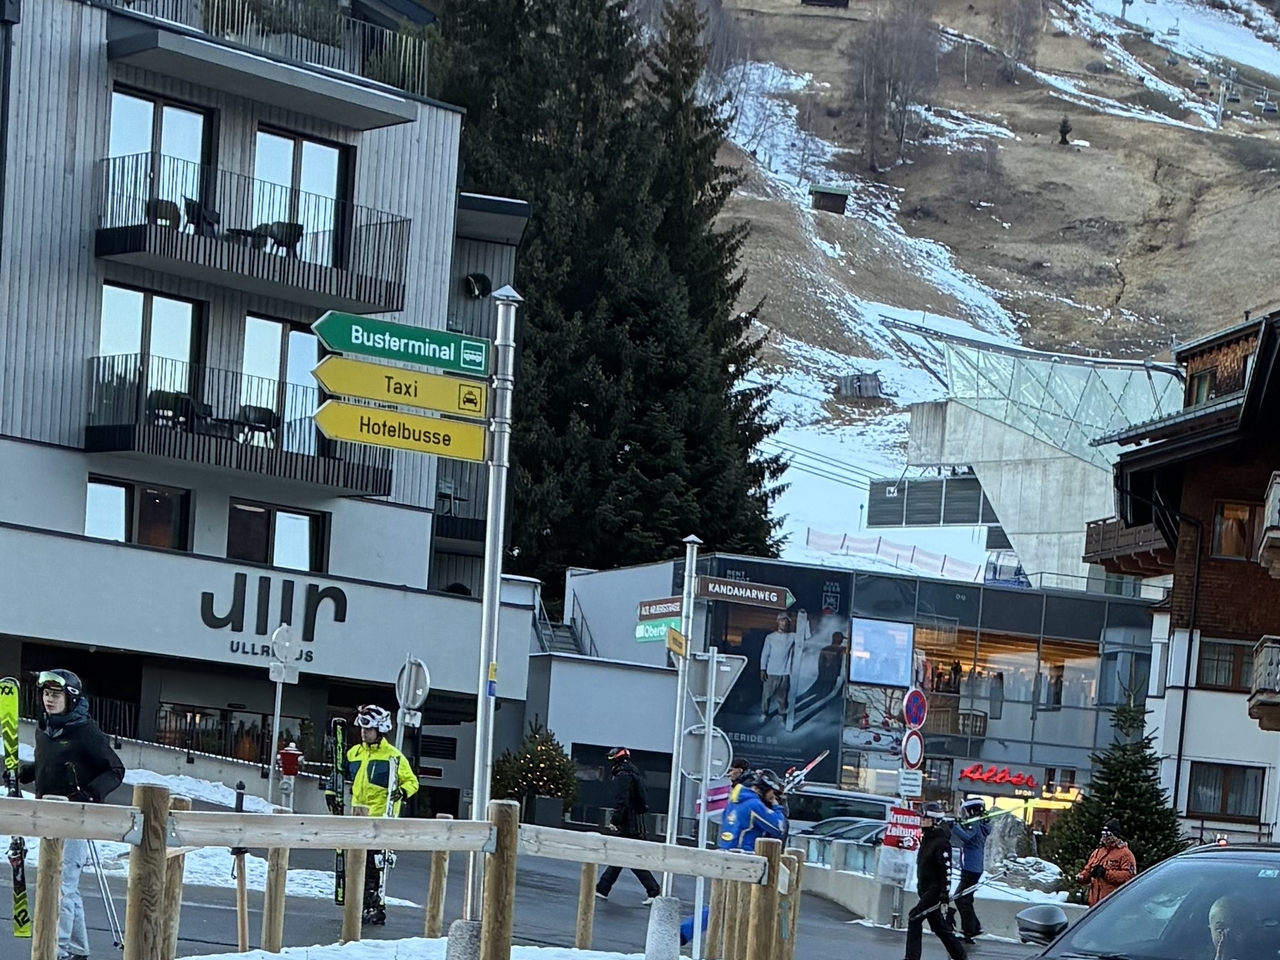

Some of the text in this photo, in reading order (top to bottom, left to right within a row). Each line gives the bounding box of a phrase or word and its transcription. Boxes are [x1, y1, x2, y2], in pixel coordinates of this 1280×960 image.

[351, 325, 455, 361] Busterminal
[384, 375, 418, 398] Taxi
[359, 415, 452, 447] Hotelbusse
[708, 583, 778, 603] KANDAHARWEG
[230, 640, 314, 663] ULLRUS
[727, 732, 763, 743] EERIDE
[958, 763, 1039, 788] Alber
